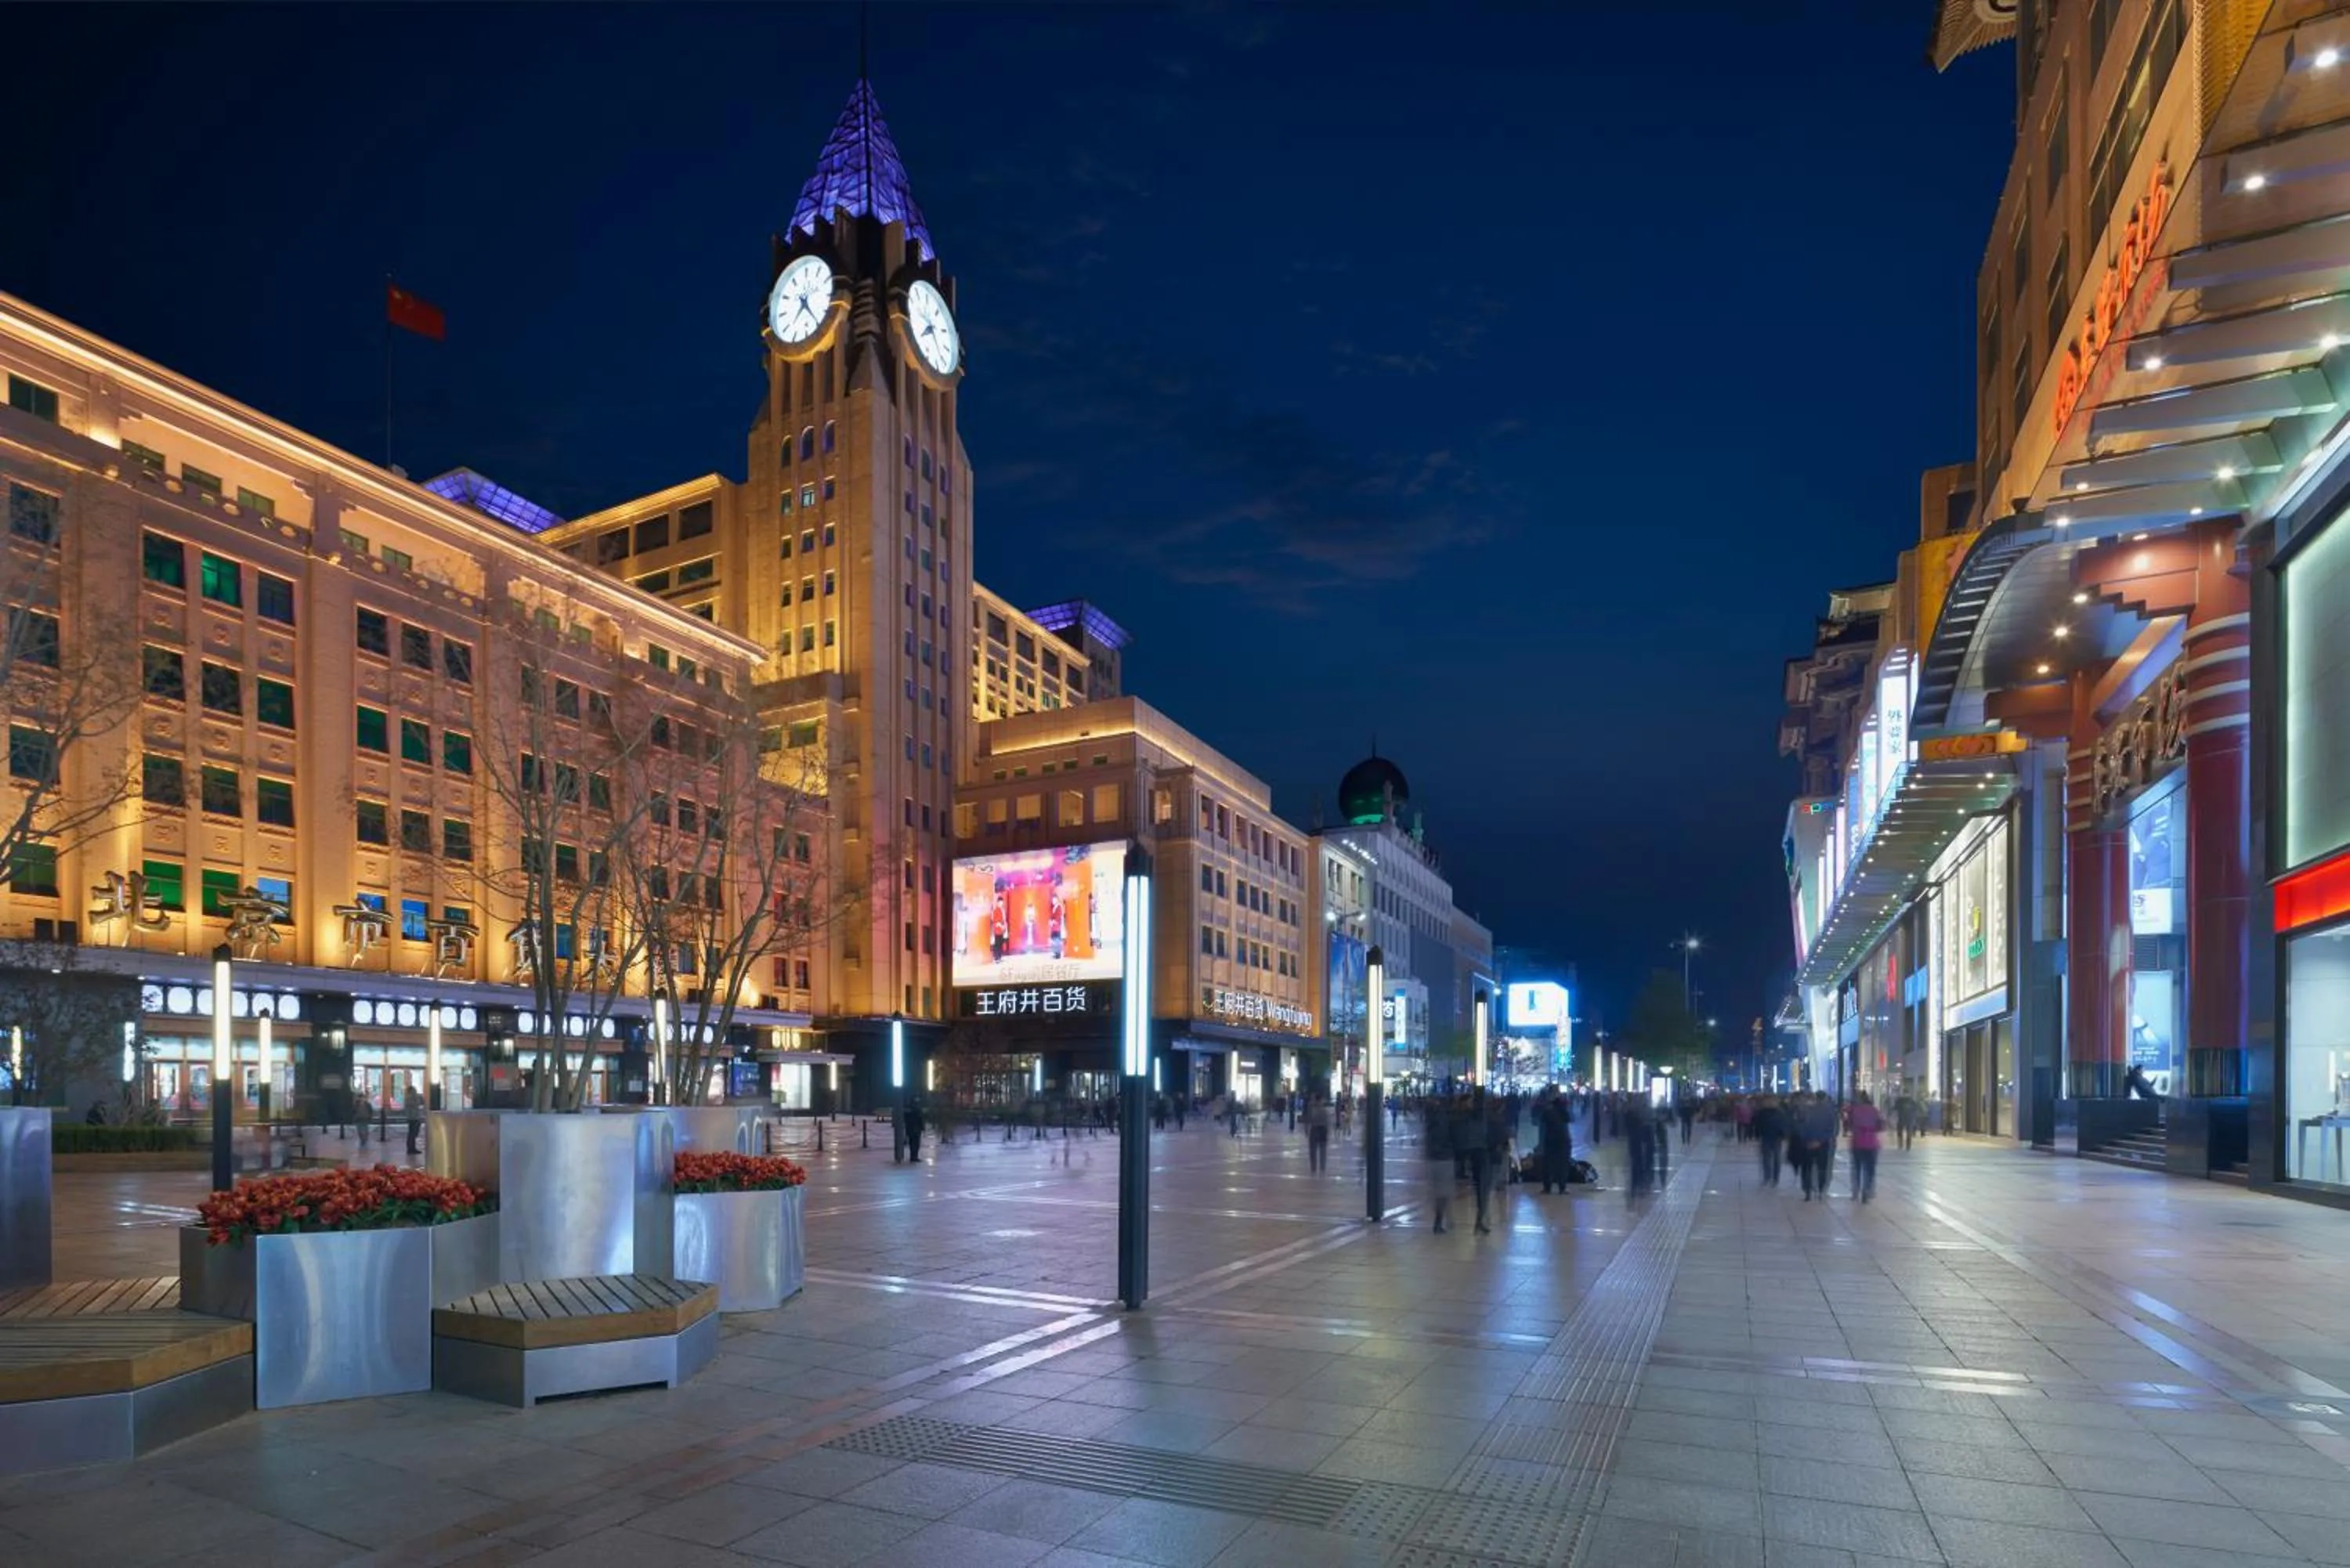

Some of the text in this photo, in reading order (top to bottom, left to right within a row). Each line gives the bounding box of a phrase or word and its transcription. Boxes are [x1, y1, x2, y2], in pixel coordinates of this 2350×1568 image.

[88, 870, 678, 989] 北京市百货大
[975, 985, 1087, 1016] 王府井百货
[1213, 989, 1264, 1021] 王府井百货
